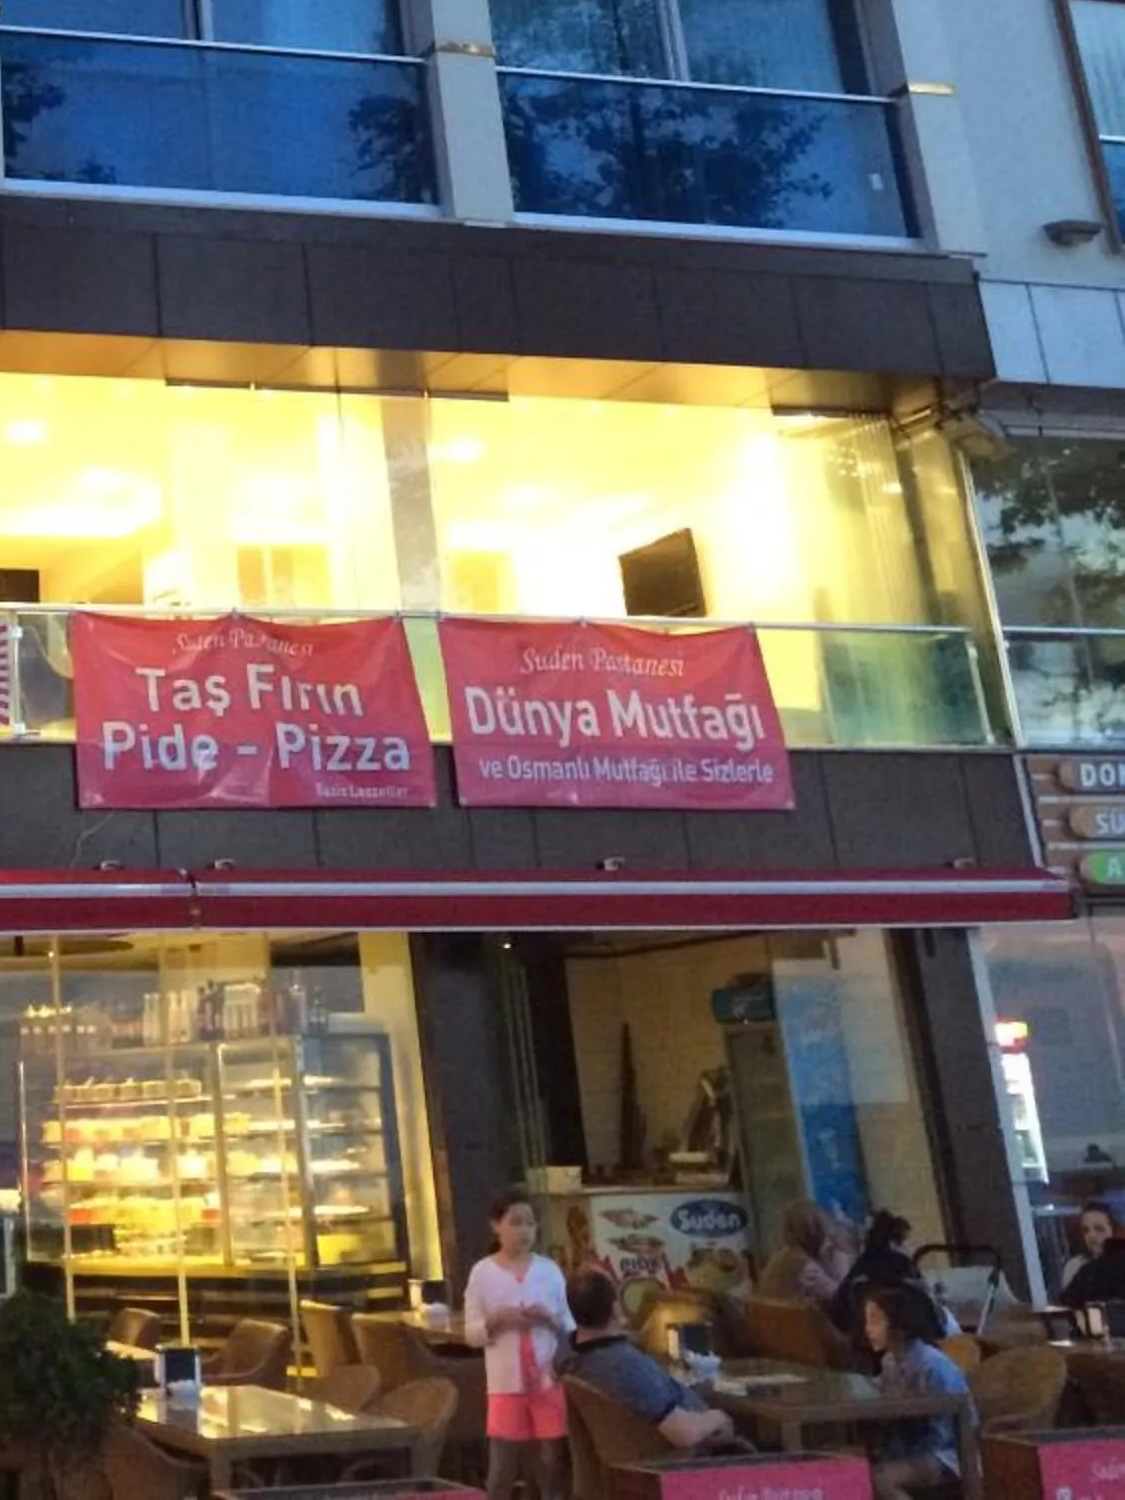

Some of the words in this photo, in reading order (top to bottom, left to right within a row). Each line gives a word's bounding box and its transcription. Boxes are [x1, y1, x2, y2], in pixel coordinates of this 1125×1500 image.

[519, 647, 585, 676] Suden
[591, 647, 685, 677] Pastanesi
[135, 666, 231, 717] Taş
[246, 662, 364, 717] Fırın
[464, 685, 600, 749] Dünya
[606, 688, 767, 752] Mutfağı
[101, 720, 220, 772] Pide
[275, 720, 411, 772] Pizza
[479, 760, 503, 780] ve
[507, 754, 591, 784] Osmanlı
[1080, 762, 1125, 788] DO
[677, 1209, 742, 1232] Suden
